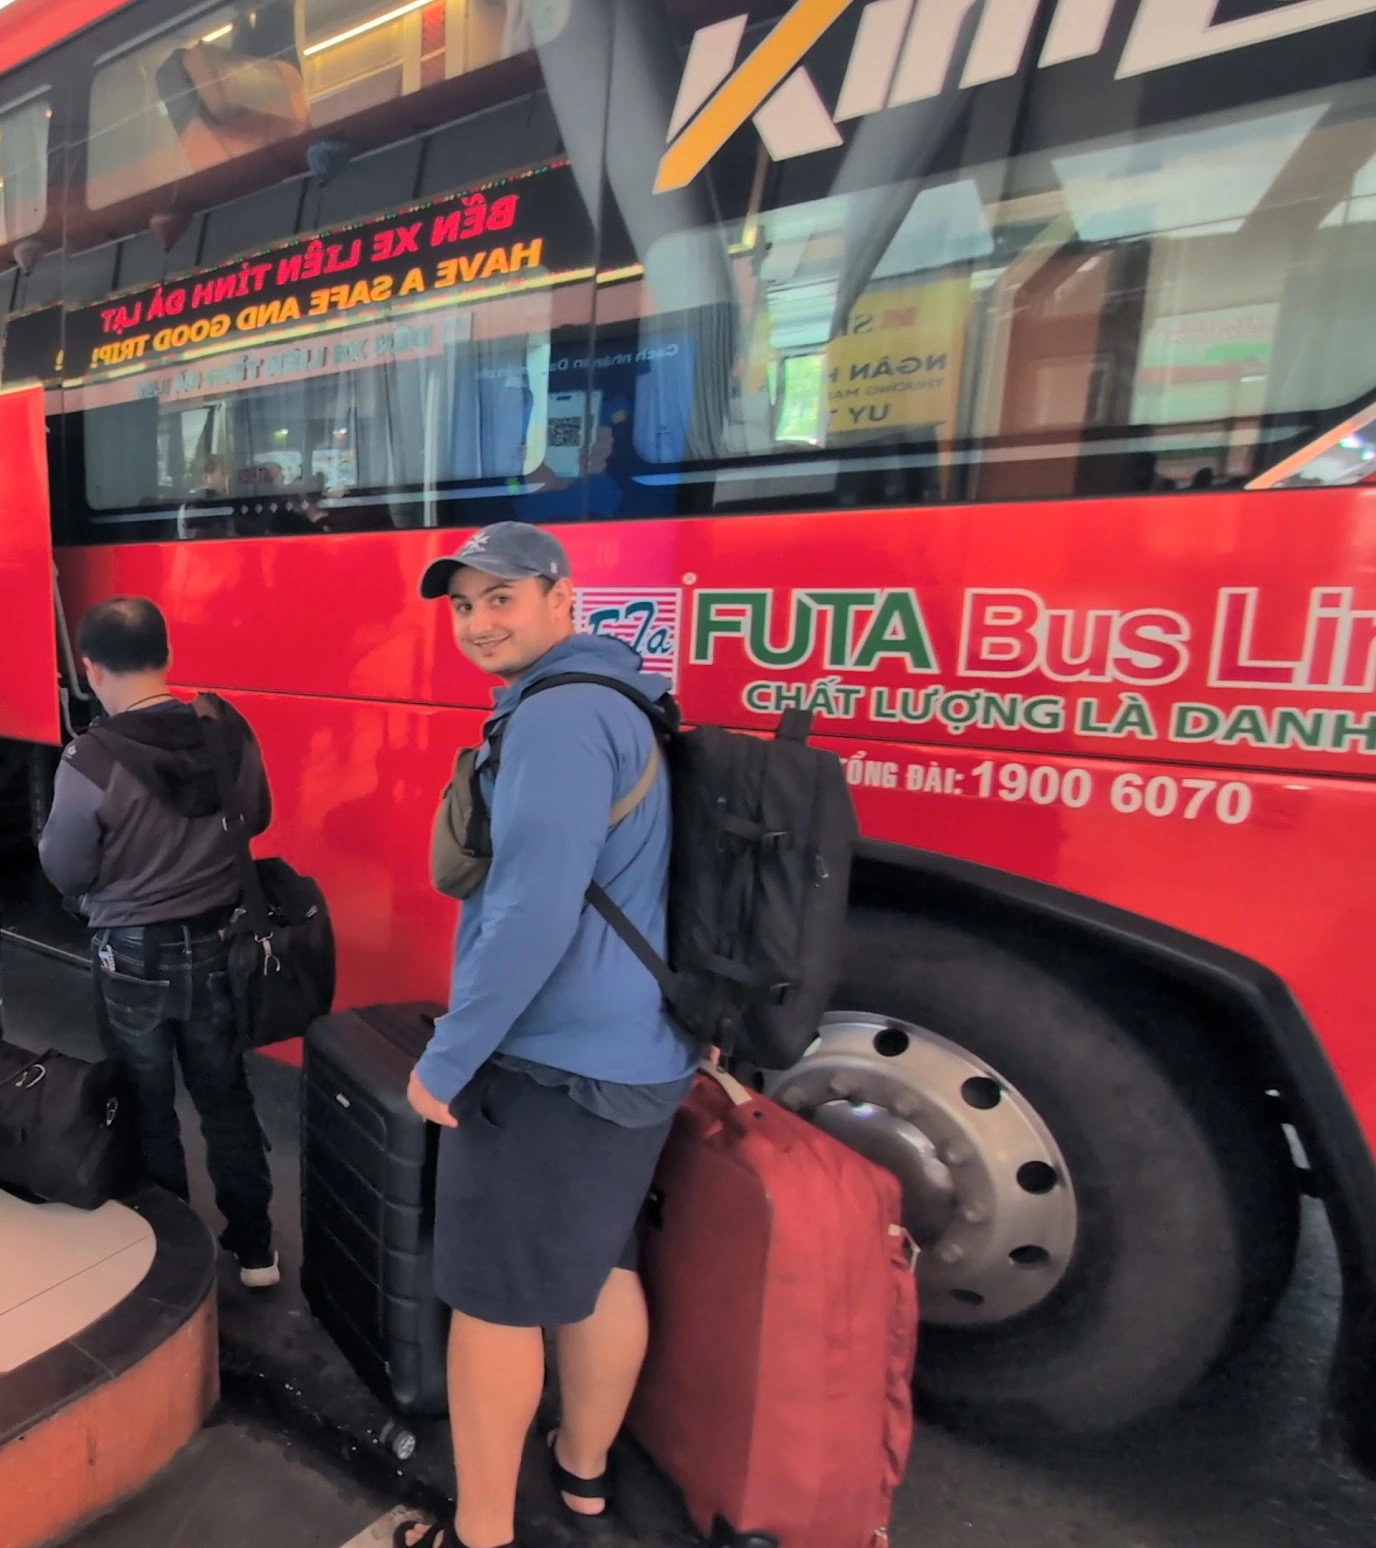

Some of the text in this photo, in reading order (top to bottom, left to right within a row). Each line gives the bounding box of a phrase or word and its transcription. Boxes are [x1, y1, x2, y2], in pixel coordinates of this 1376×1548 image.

[689, 588, 940, 674] FUTA
[956, 587, 1191, 686] Bus
[741, 675, 1376, 755] CHẤT LƯỢNG LÀ DANH
[905, 761, 965, 795] ĐÀI:
[971, 761, 1092, 808] 1900
[1110, 773, 1252, 824] 6070
